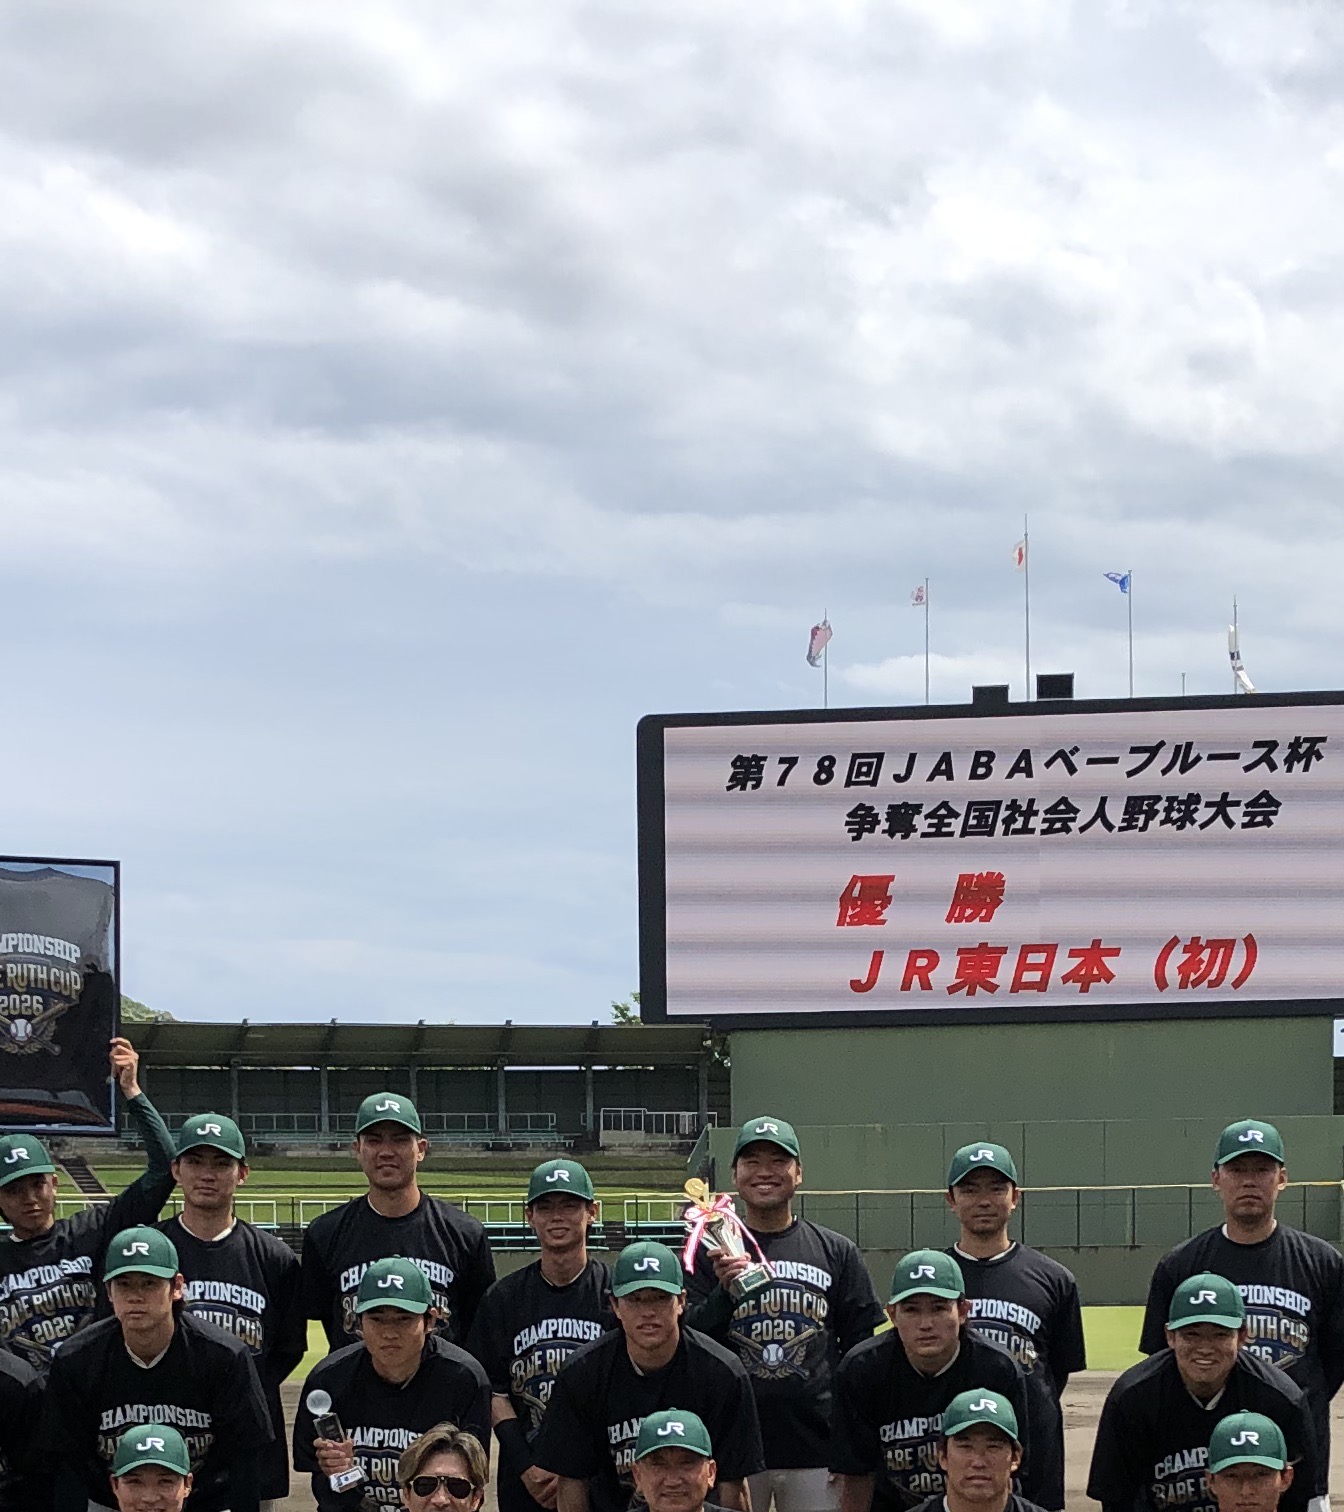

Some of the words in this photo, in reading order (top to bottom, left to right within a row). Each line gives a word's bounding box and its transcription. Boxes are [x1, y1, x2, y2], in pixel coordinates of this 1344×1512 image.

[843, 789, 1283, 842] 争奪全国社会人野球大会
[5, 963, 49, 992] RUTH
[50, 968, 82, 999] CUP
[376, 1099, 401, 1113] JR
[197, 1123, 222, 1137] JR
[755, 1122, 779, 1135] JR
[1238, 1129, 1264, 1143] JR
[4, 1147, 30, 1163] JR
[969, 1149, 994, 1162] JR
[545, 1169, 570, 1182] JR
[122, 1242, 149, 1256] JR
[634, 1257, 660, 1272] JR
[909, 1265, 936, 1280] JR
[377, 1274, 404, 1289] JR
[33, 1281, 73, 1314] RUTH
[1190, 1290, 1217, 1305] JR
[1239, 1284, 1312, 1316] PIONSHIP
[966, 1299, 1042, 1335] PIONSHIP
[31, 1314, 75, 1344] 2026
[513, 1317, 606, 1356] CHAMPIONSH
[751, 1319, 795, 1340] 2026
[1246, 1315, 1277, 1345] UTH
[969, 1398, 998, 1414] JR
[100, 1404, 212, 1431] HAMPIONSHIP
[657, 1422, 685, 1437] JR
[880, 1413, 943, 1442] CHAMPIO
[136, 1437, 165, 1452] JR
[1230, 1431, 1260, 1446] JR
[884, 1449, 915, 1471] ABE
[908, 1474, 946, 1493] 202
